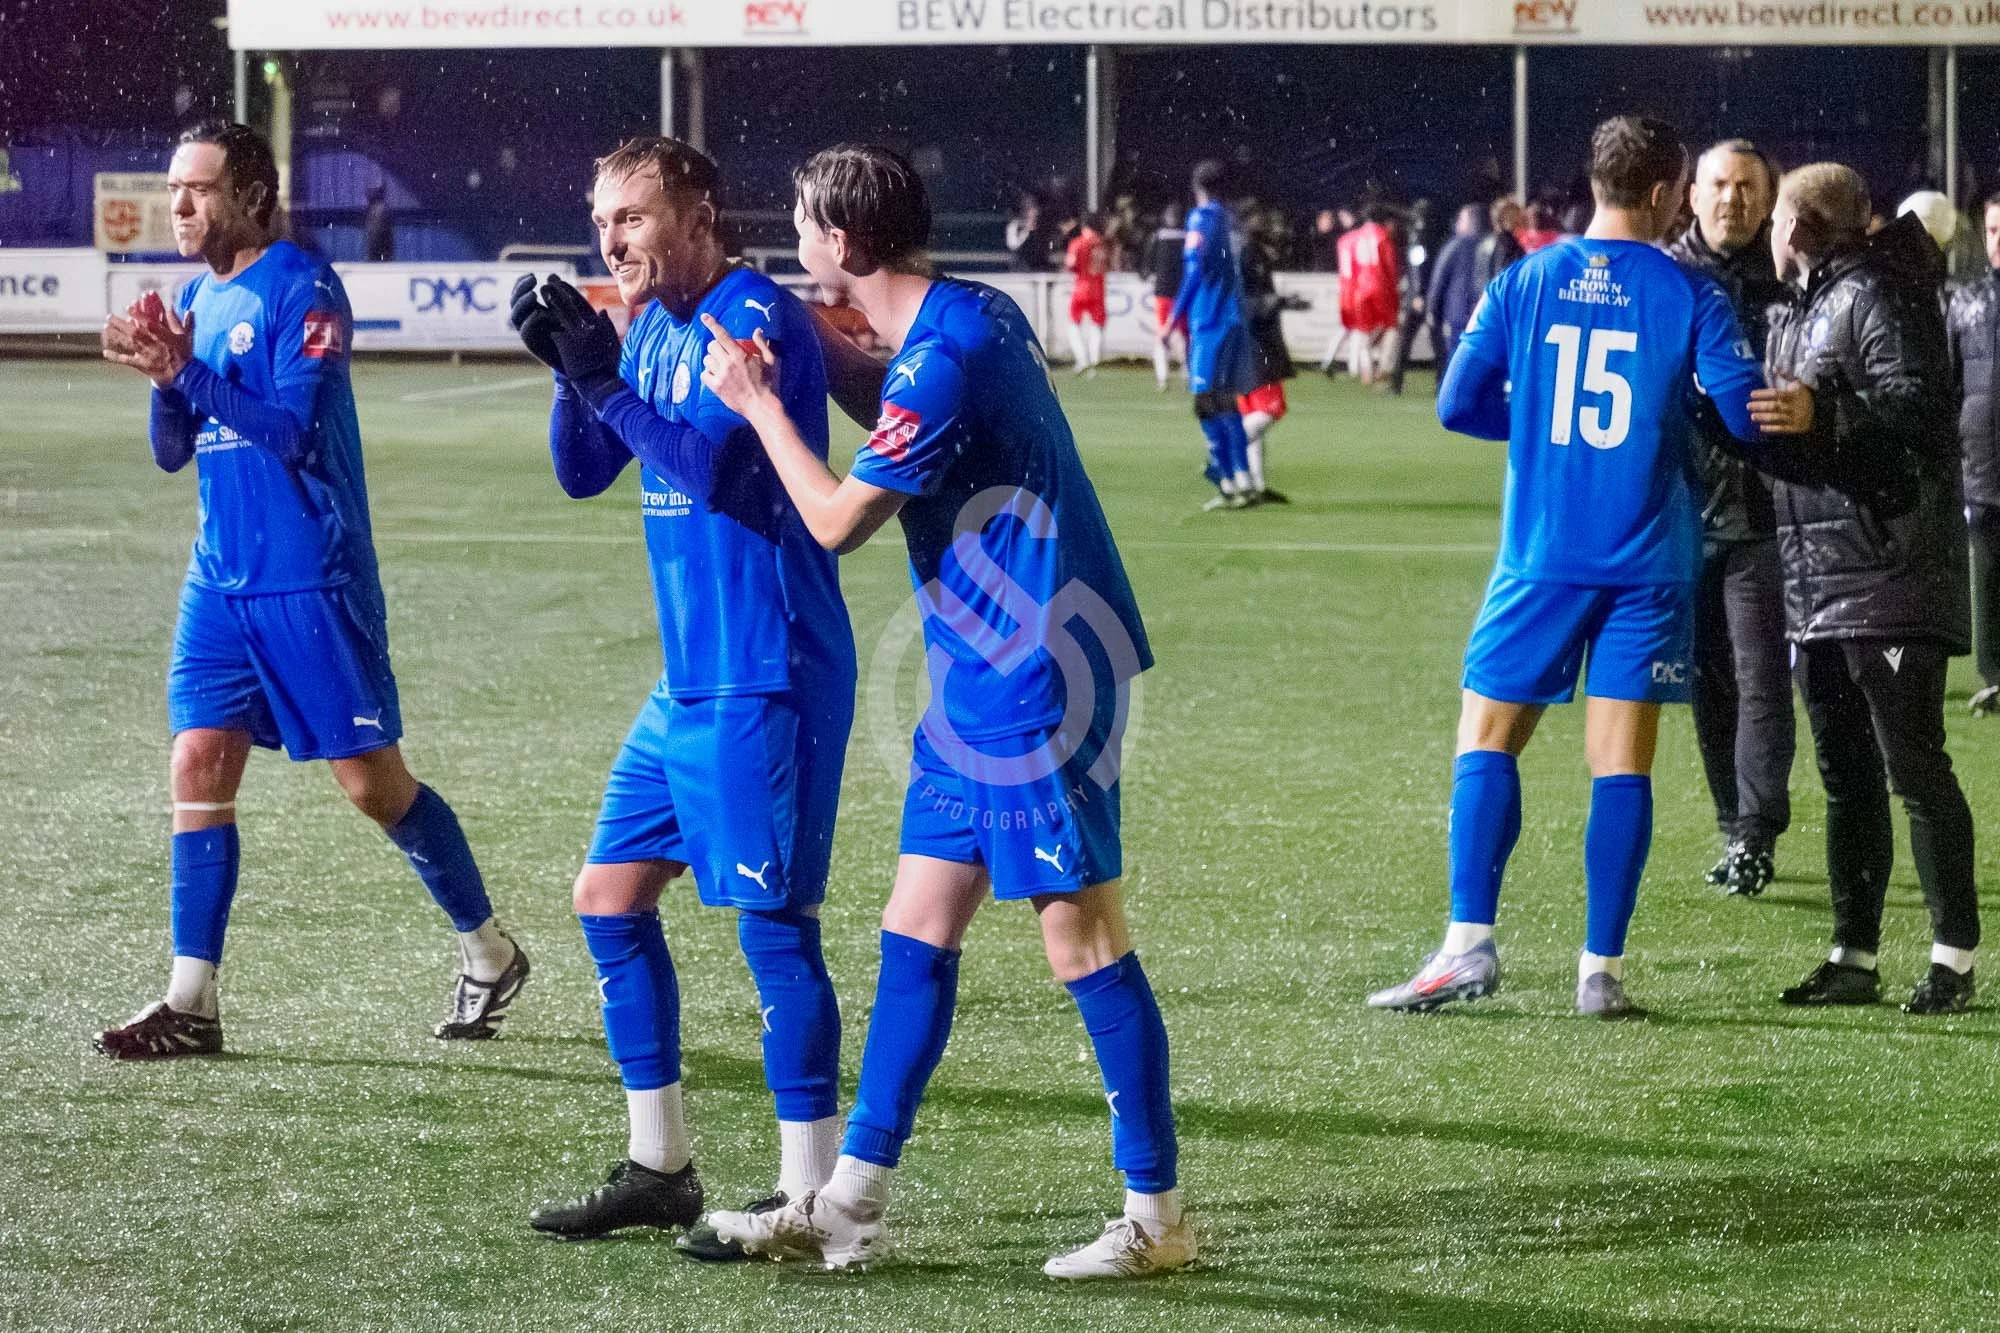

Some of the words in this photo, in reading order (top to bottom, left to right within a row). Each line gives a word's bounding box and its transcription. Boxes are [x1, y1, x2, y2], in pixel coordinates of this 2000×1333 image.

[897, 0, 985, 30] BEW
[1003, 0, 1188, 30] Electrical
[1202, 0, 1438, 31] Distributors
[1569, 278, 1623, 296] CROWN
[1583, 267, 1611, 281] THE
[409, 276, 497, 313] DMC
[1558, 287, 1632, 308] BILLERICAY
[1543, 323, 1638, 450] 15
